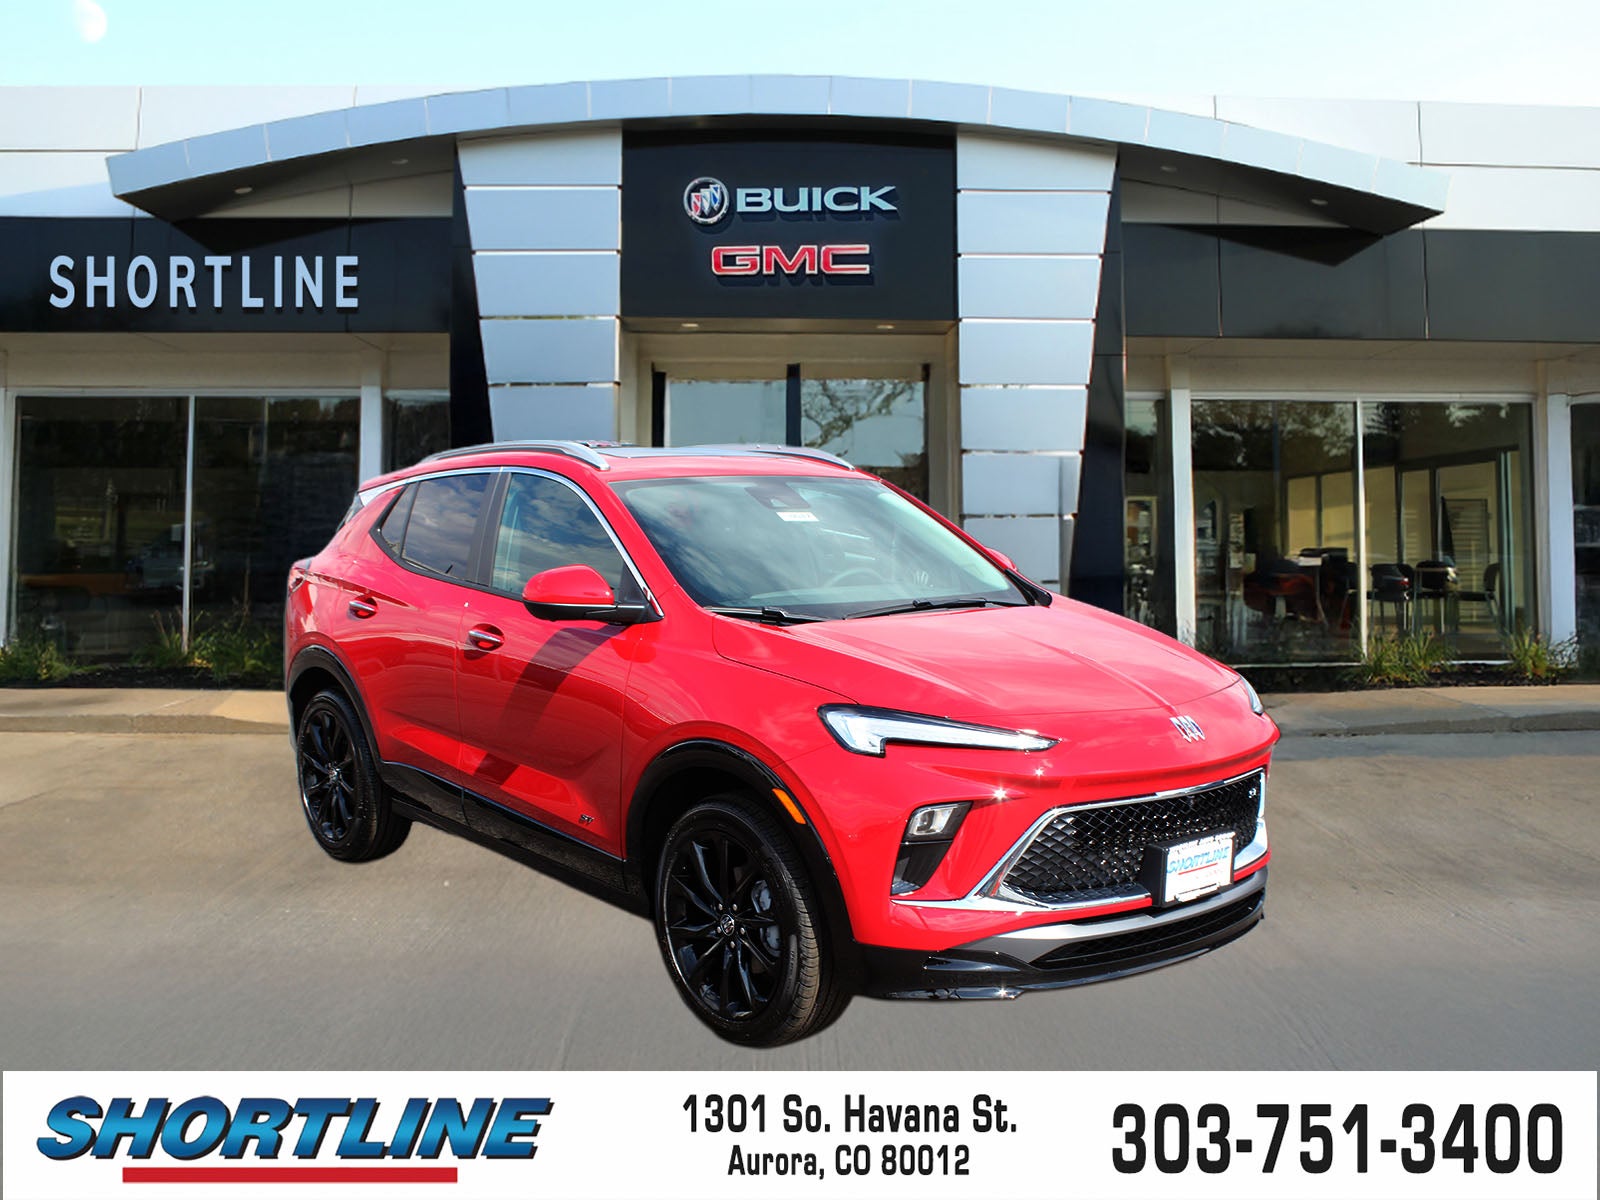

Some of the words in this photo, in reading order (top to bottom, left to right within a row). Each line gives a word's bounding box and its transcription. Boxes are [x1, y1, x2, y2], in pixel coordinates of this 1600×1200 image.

[736, 185, 898, 213] BUICK
[711, 243, 871, 276] GMC
[49, 255, 360, 309] SHORTLINE
